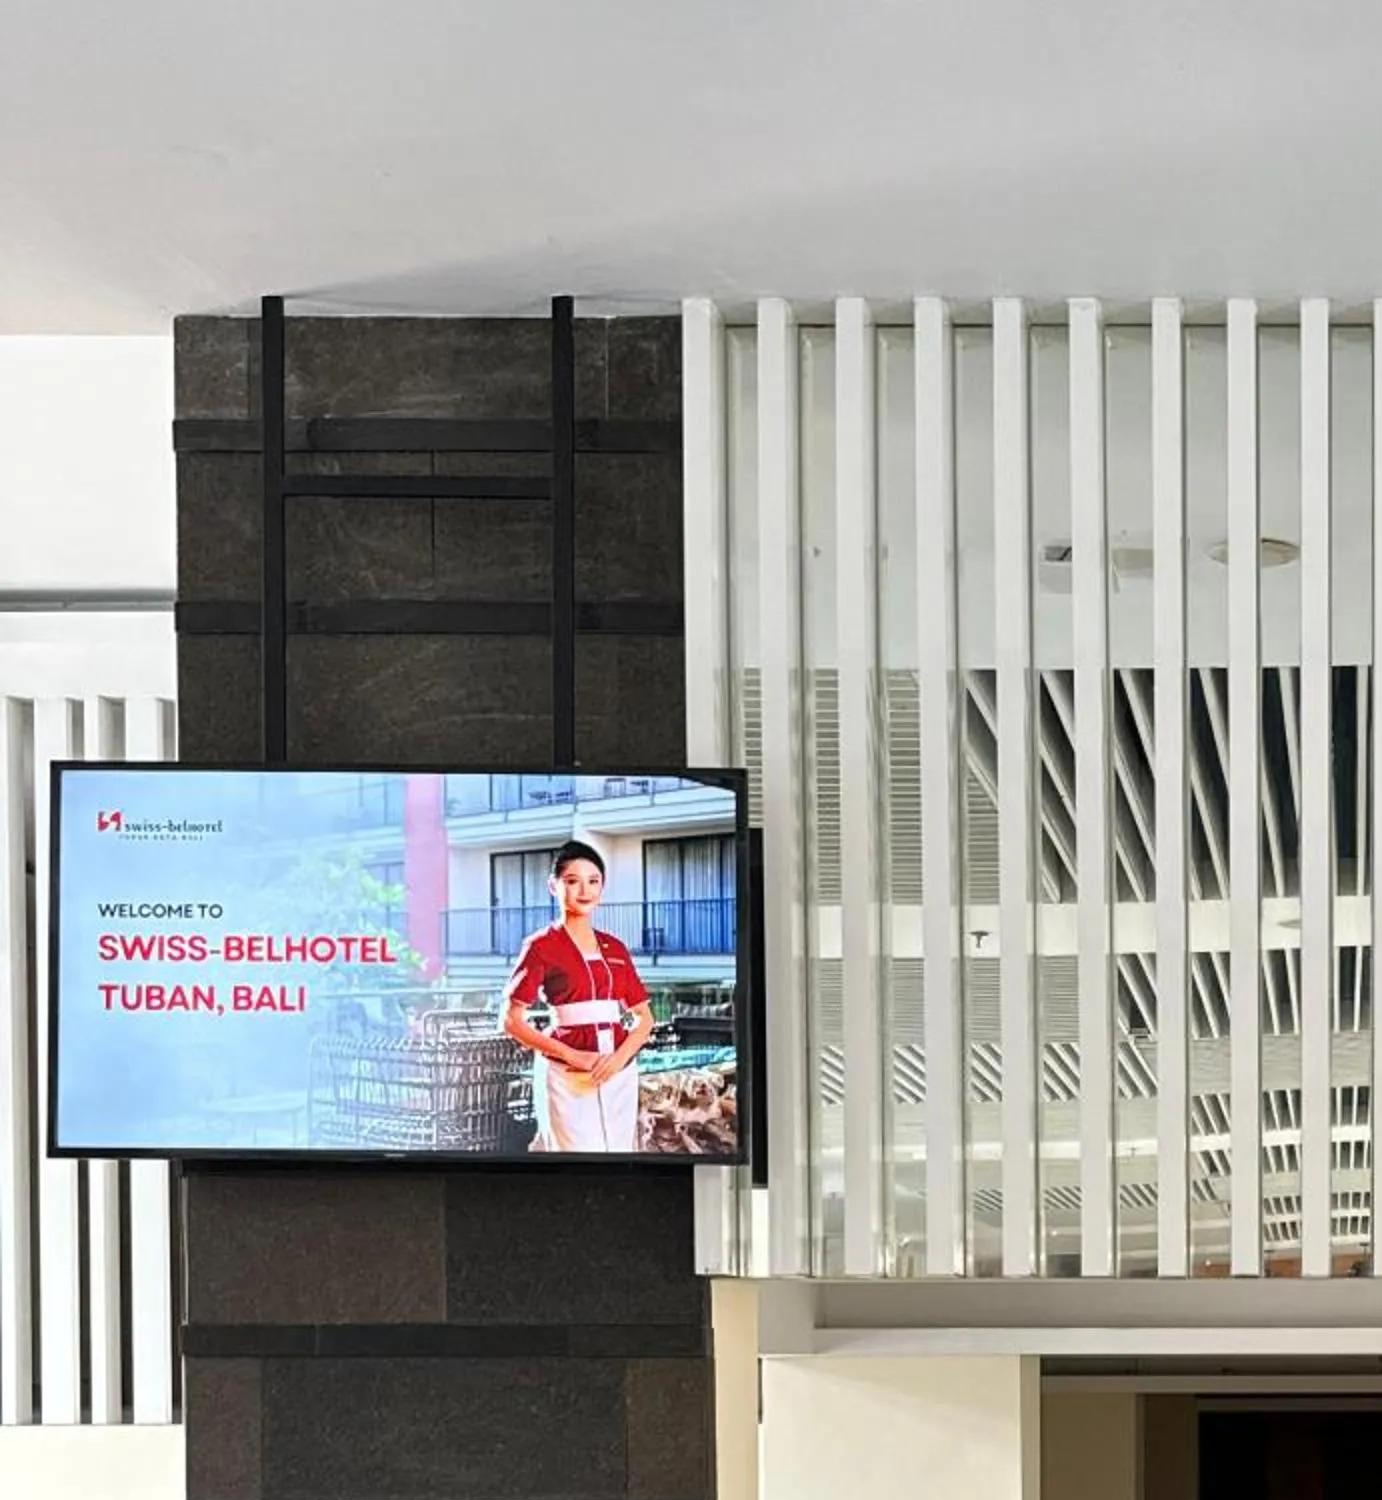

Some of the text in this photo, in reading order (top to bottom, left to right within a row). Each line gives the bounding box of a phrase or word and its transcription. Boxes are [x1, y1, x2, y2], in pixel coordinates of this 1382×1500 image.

[98, 903, 223, 918] WELCOME TO
[98, 934, 397, 964] SWISS-BELHOTEL
[98, 984, 306, 1016] TUBAN, BALI
